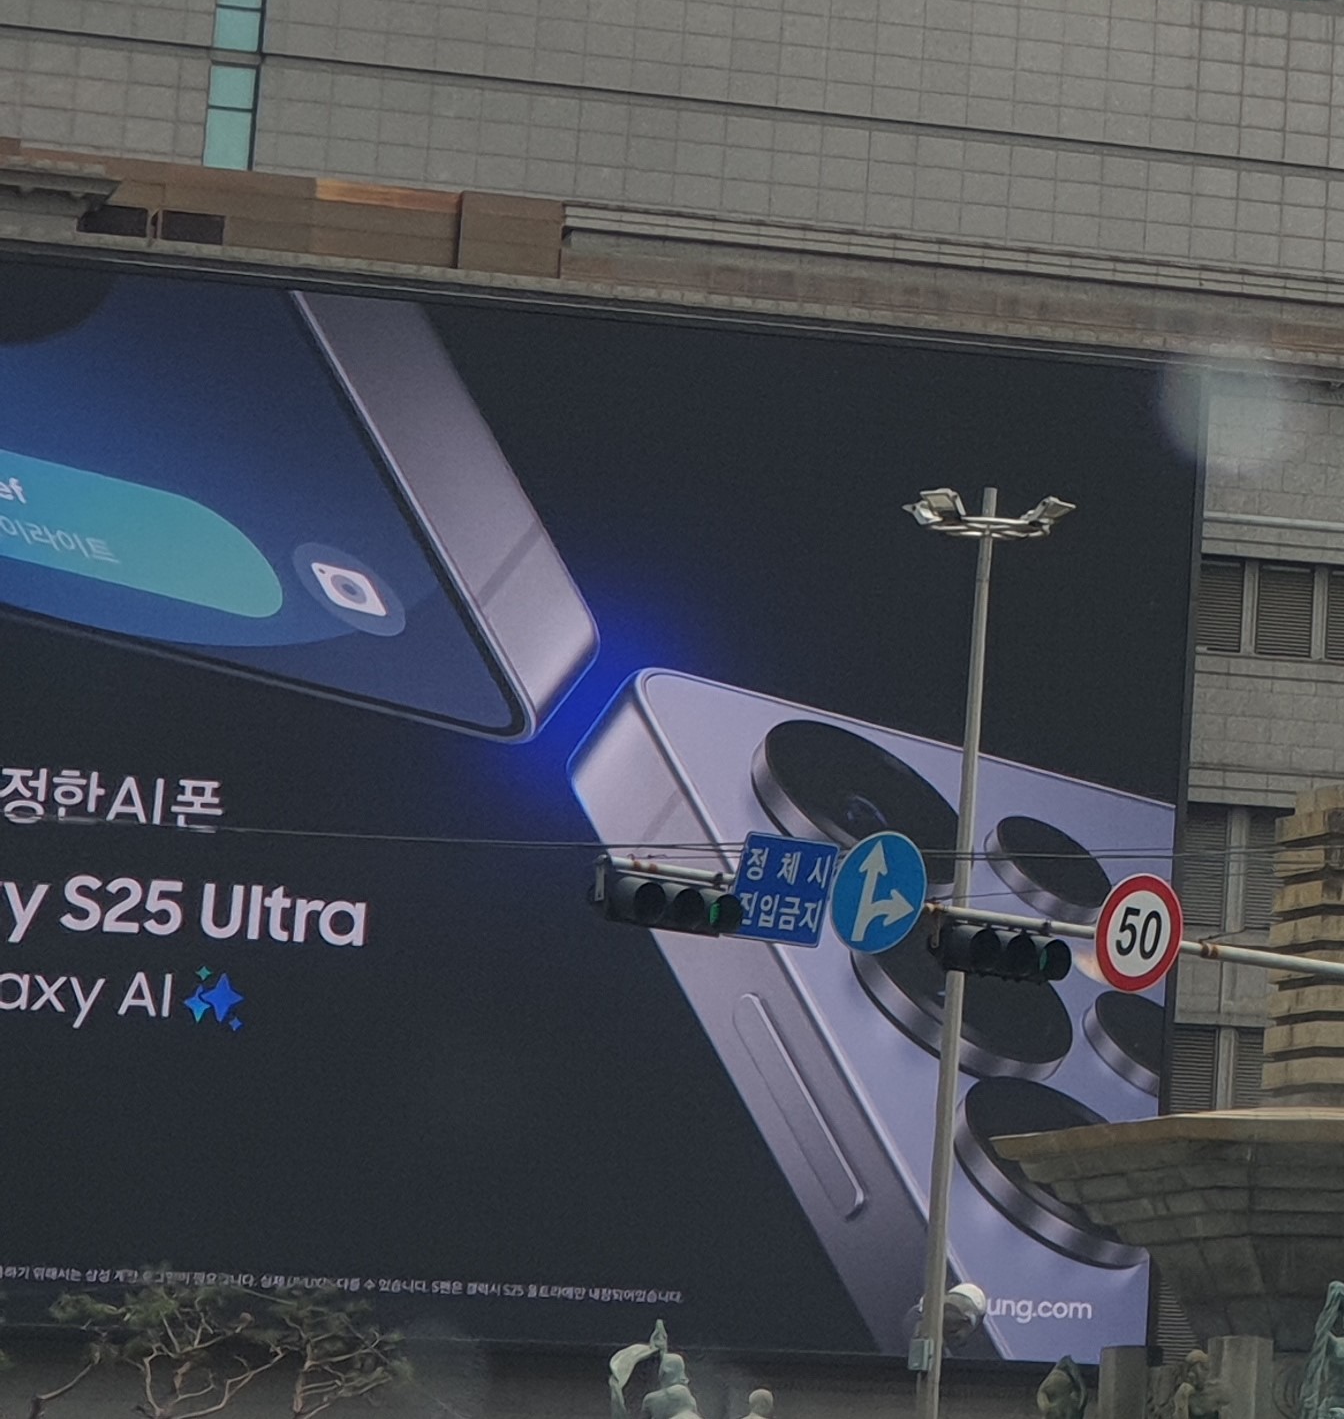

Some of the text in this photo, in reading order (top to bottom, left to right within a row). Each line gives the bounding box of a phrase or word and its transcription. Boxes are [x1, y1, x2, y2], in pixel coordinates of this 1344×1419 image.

[0, 874, 368, 948] y S25 Ultra
[739, 891, 824, 933] 진입금지
[1115, 905, 1163, 961] 50
[117, 971, 174, 1018] AI
[502, 1283, 524, 1297] S25
[986, 1298, 1093, 1324] ung.com
